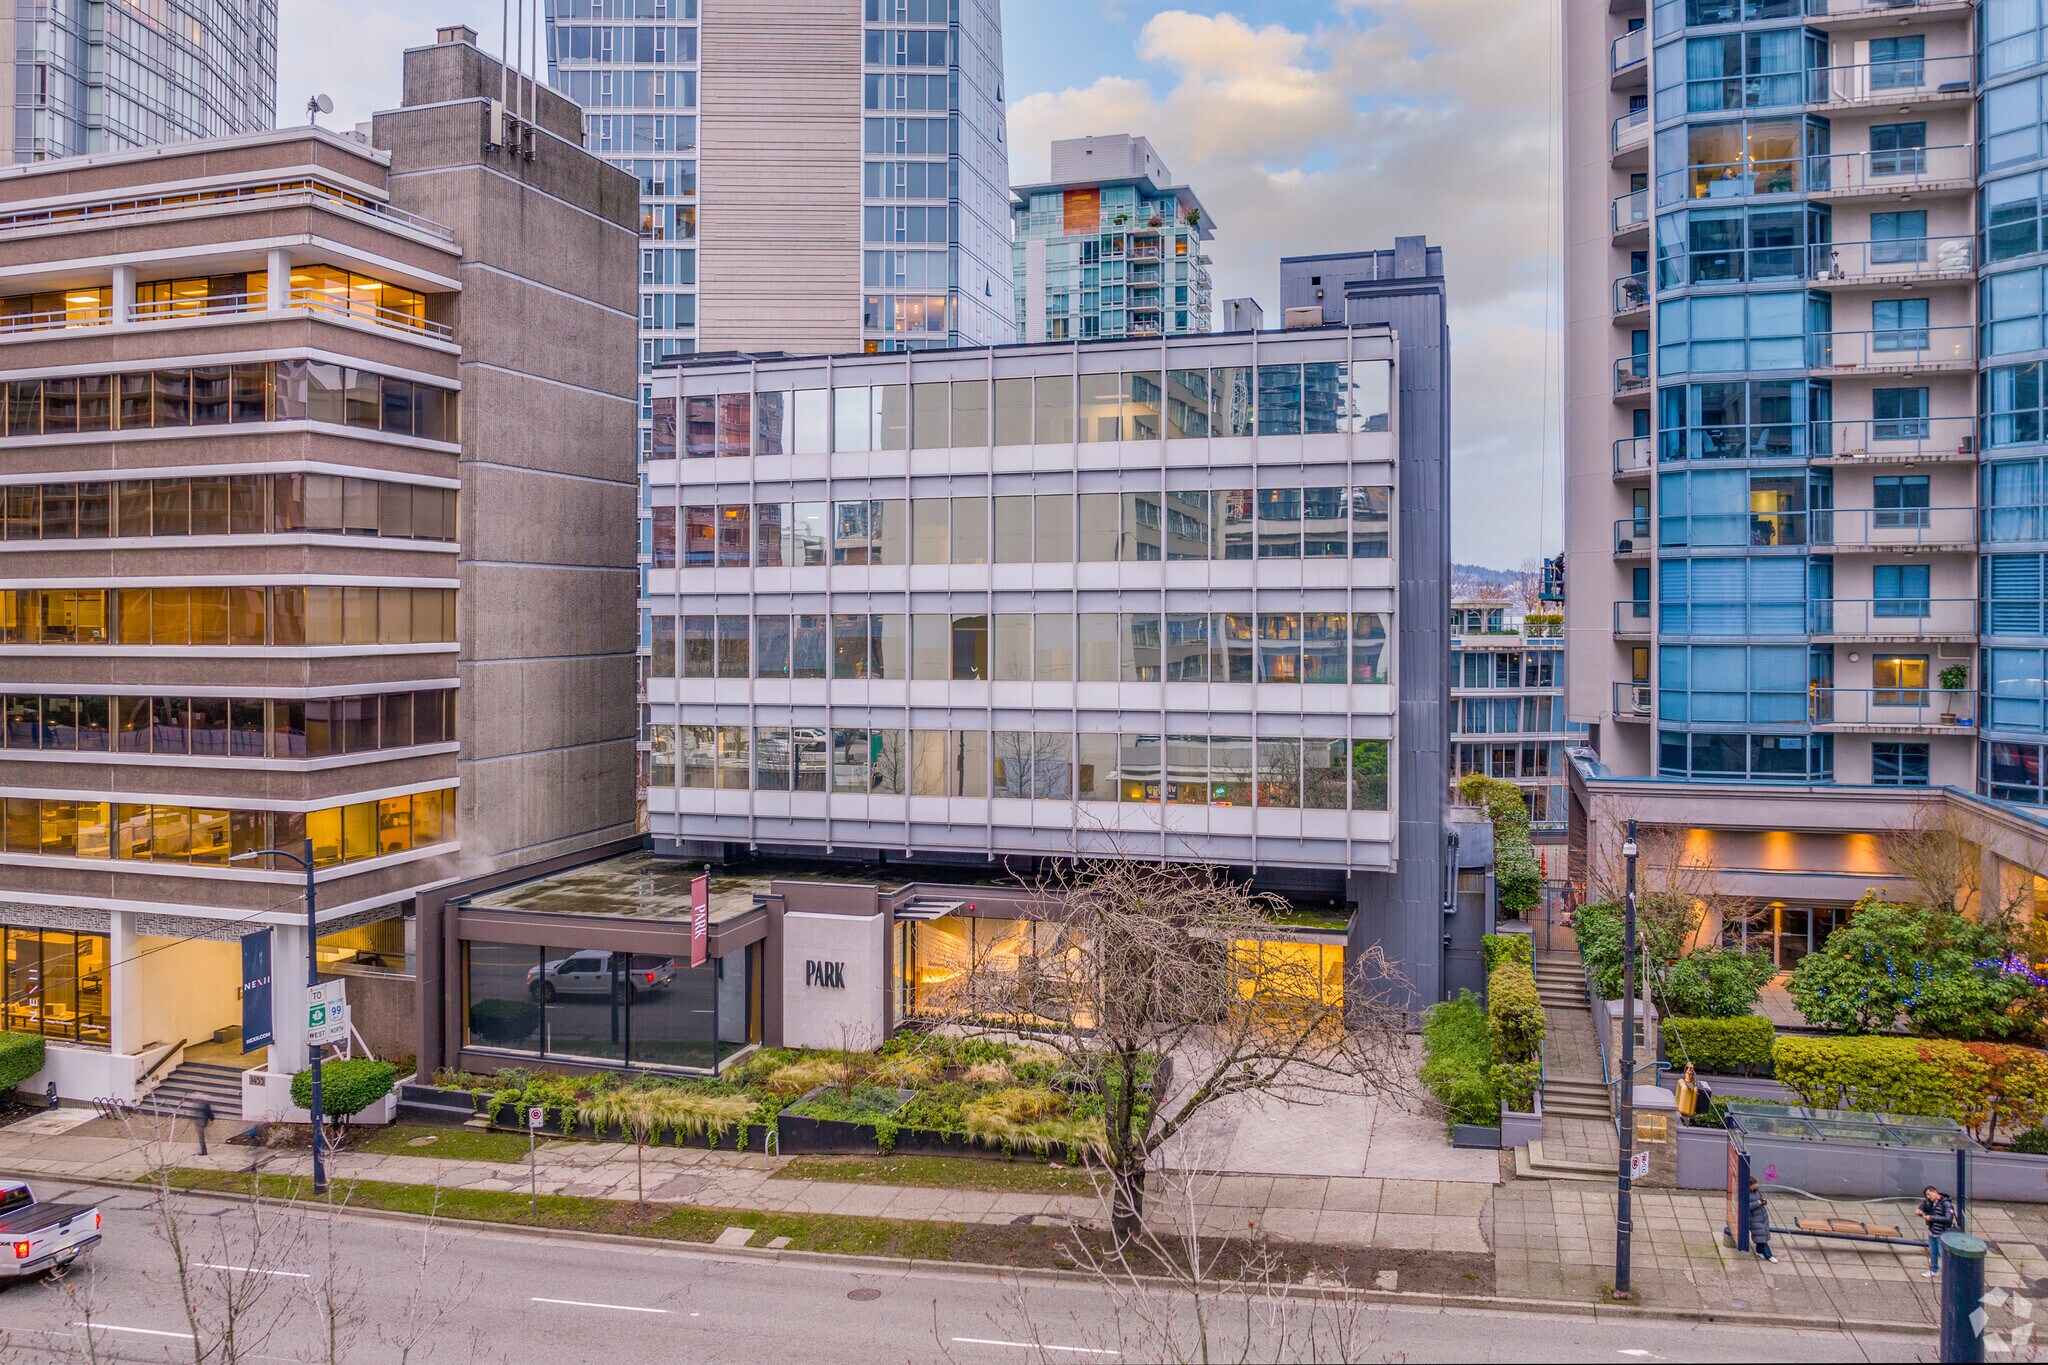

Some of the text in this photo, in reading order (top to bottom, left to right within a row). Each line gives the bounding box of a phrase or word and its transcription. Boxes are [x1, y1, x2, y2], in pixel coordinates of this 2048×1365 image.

[694, 903, 706, 940] PARK
[1262, 933, 1298, 942] GEORGIA
[805, 959, 846, 989] PARK
[244, 975, 271, 991] NEXII
[28, 969, 39, 1022] NEXII
[312, 991, 322, 1000] TO
[331, 1005, 342, 1016] 99
[309, 1030, 325, 1039] WEST
[330, 1025, 344, 1033] NORTH
